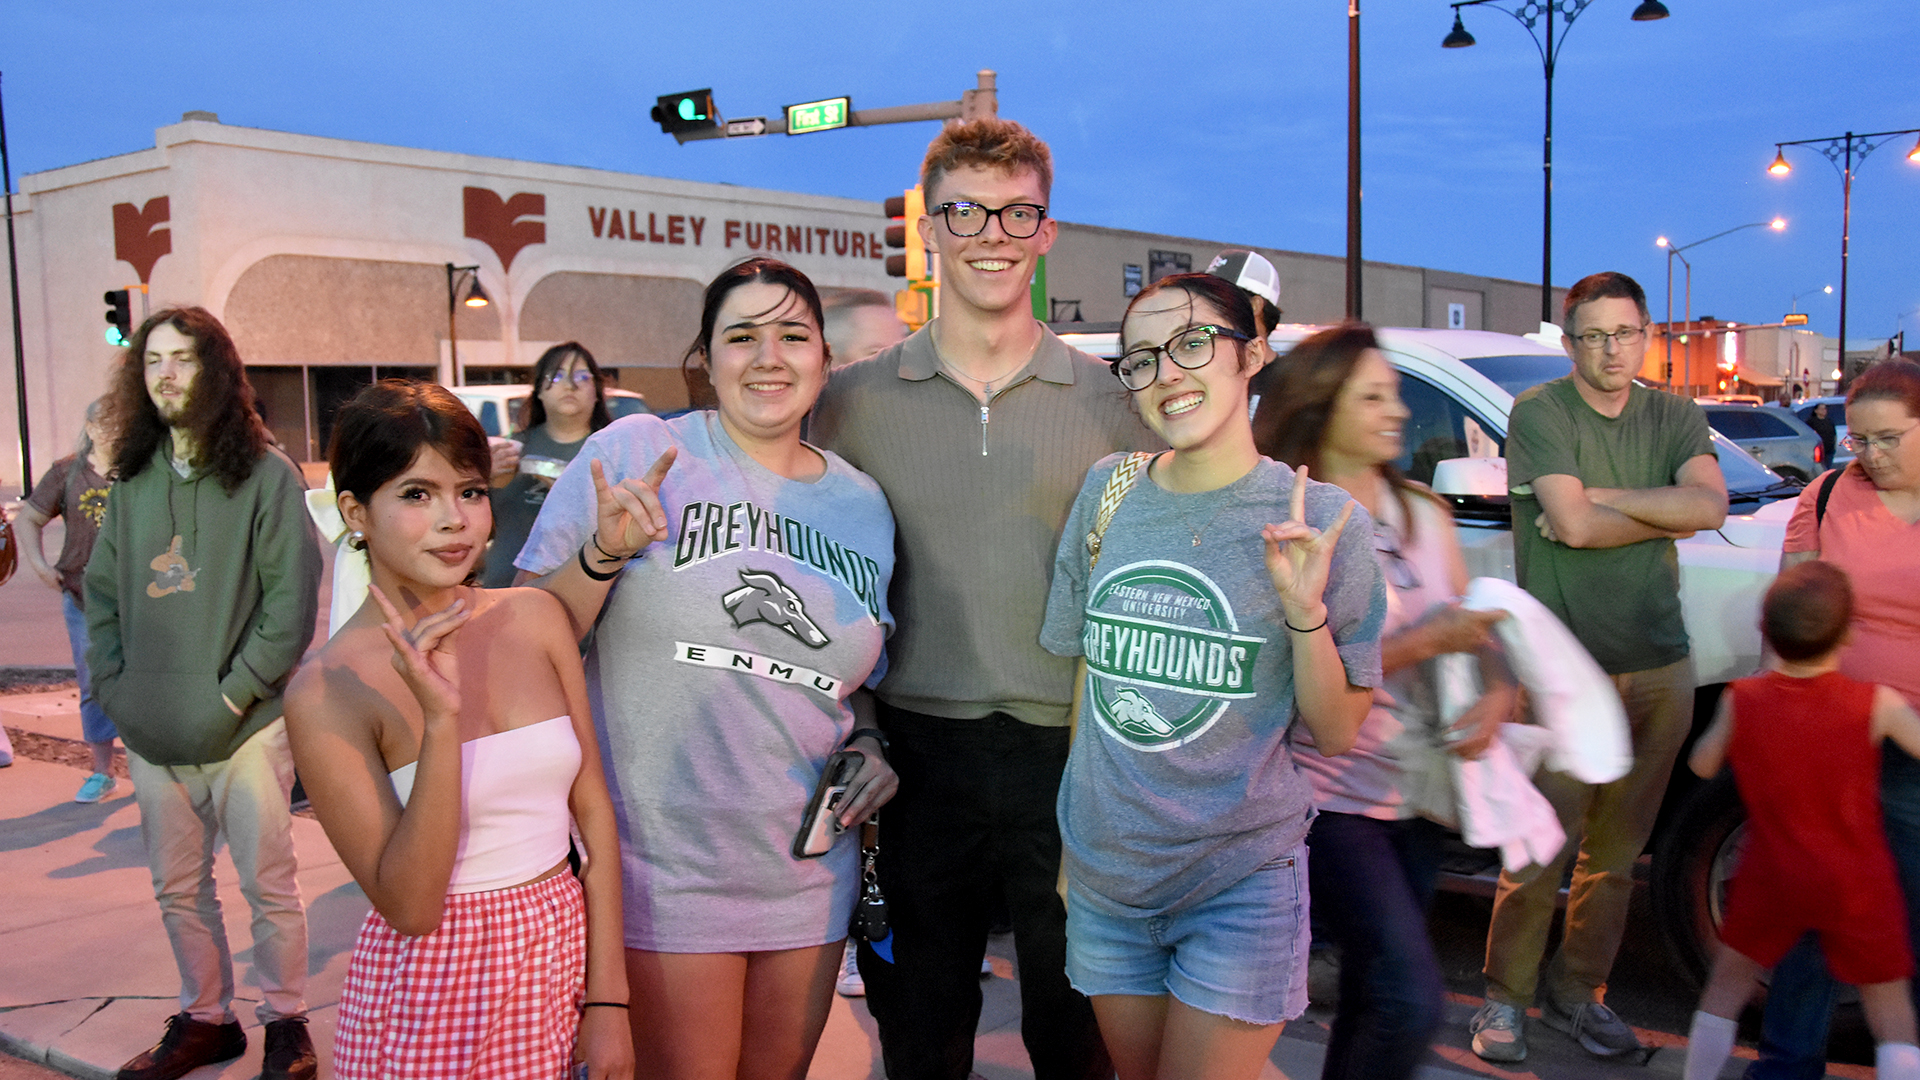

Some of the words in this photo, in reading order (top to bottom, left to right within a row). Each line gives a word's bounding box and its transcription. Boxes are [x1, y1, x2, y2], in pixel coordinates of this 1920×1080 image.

[795, 109, 821, 127] First
[824, 104, 839, 123] St
[588, 206, 706, 246] VALLEY
[724, 219, 883, 259] FURNITURE
[673, 501, 881, 626] GREYHOUNDS
[1108, 583, 1149, 601] EASTERN
[1151, 592, 1173, 604] NEW
[1174, 595, 1211, 610] MEXICO
[1122, 599, 1187, 619] UNIVERSITY
[687, 646, 834, 692] ENMU
